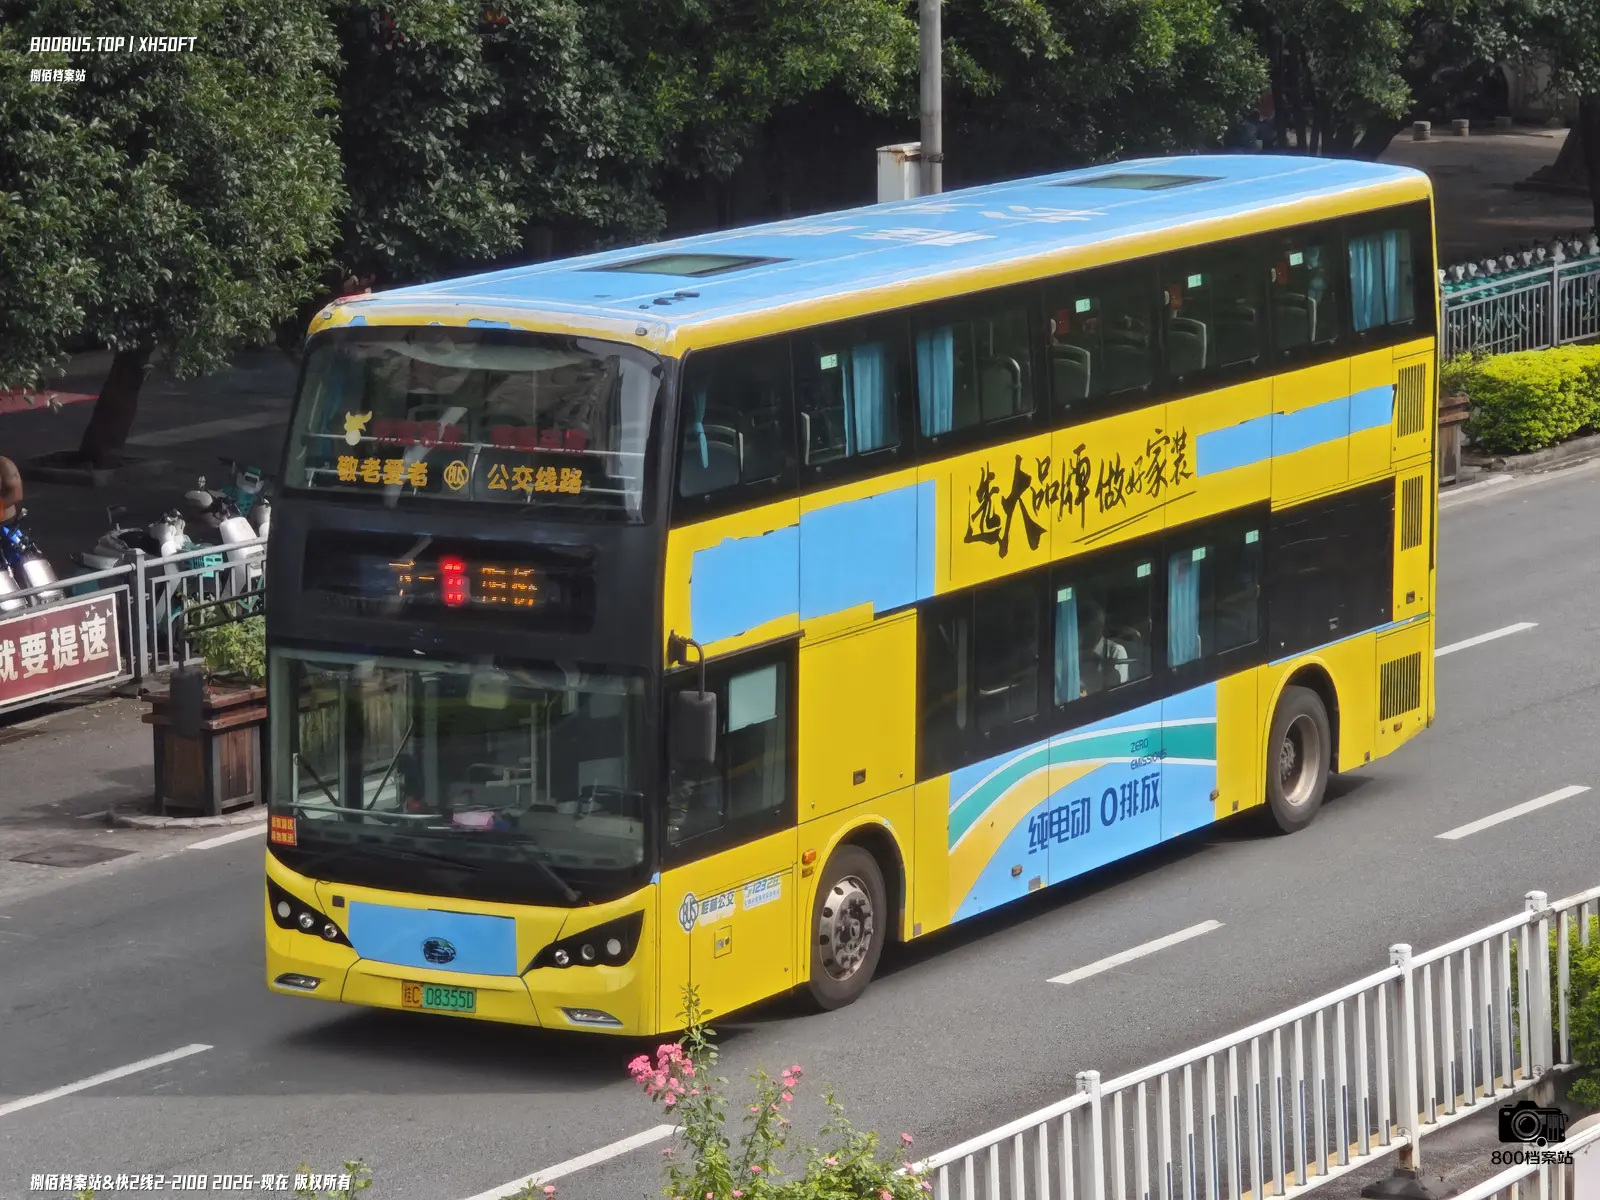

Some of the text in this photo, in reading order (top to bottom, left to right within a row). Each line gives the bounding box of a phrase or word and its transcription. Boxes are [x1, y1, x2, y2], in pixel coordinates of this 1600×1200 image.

[336, 455, 428, 487] 敬老爱老
[487, 463, 583, 494] 公交线路
[1130, 737, 1149, 753] ZERO
[1028, 796, 1091, 855] 纯电动
